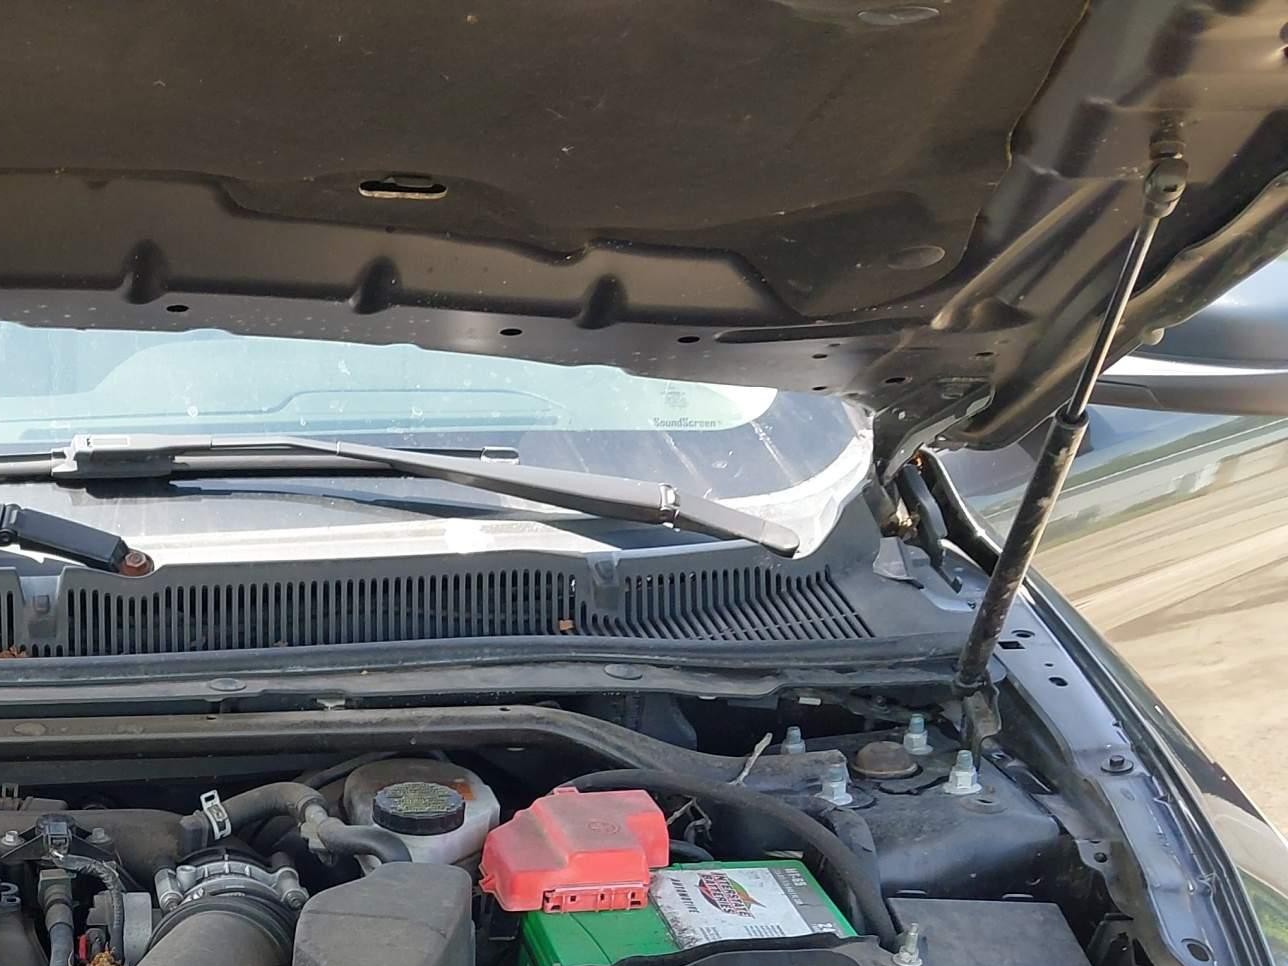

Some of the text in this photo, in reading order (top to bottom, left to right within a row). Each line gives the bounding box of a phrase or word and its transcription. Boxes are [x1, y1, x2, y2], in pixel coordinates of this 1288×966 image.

[652, 417, 717, 427] SoundScreen
[669, 877, 701, 914] AUTOMOTIVE
[701, 873, 736, 914] BATTERIES
[710, 871, 755, 918] INTERSTATE
